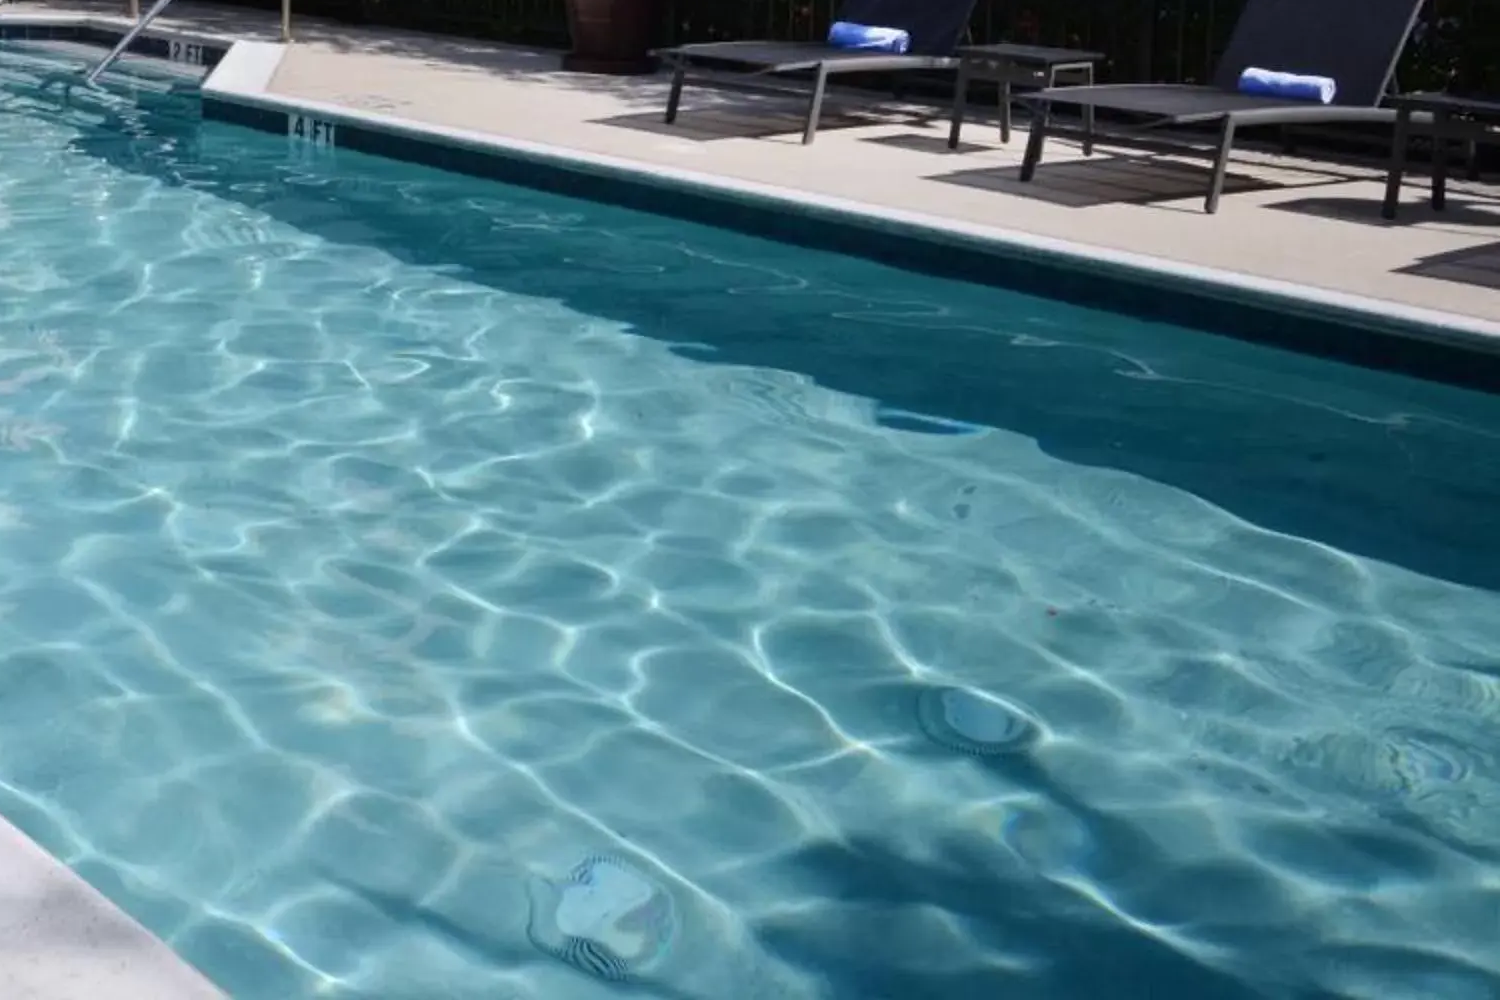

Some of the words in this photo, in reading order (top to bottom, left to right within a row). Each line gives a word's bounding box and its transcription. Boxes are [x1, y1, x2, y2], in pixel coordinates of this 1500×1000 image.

[173, 42, 181, 60] 2
[186, 44, 201, 63] FT
[294, 116, 304, 138] 4
[312, 119, 333, 144] FT
